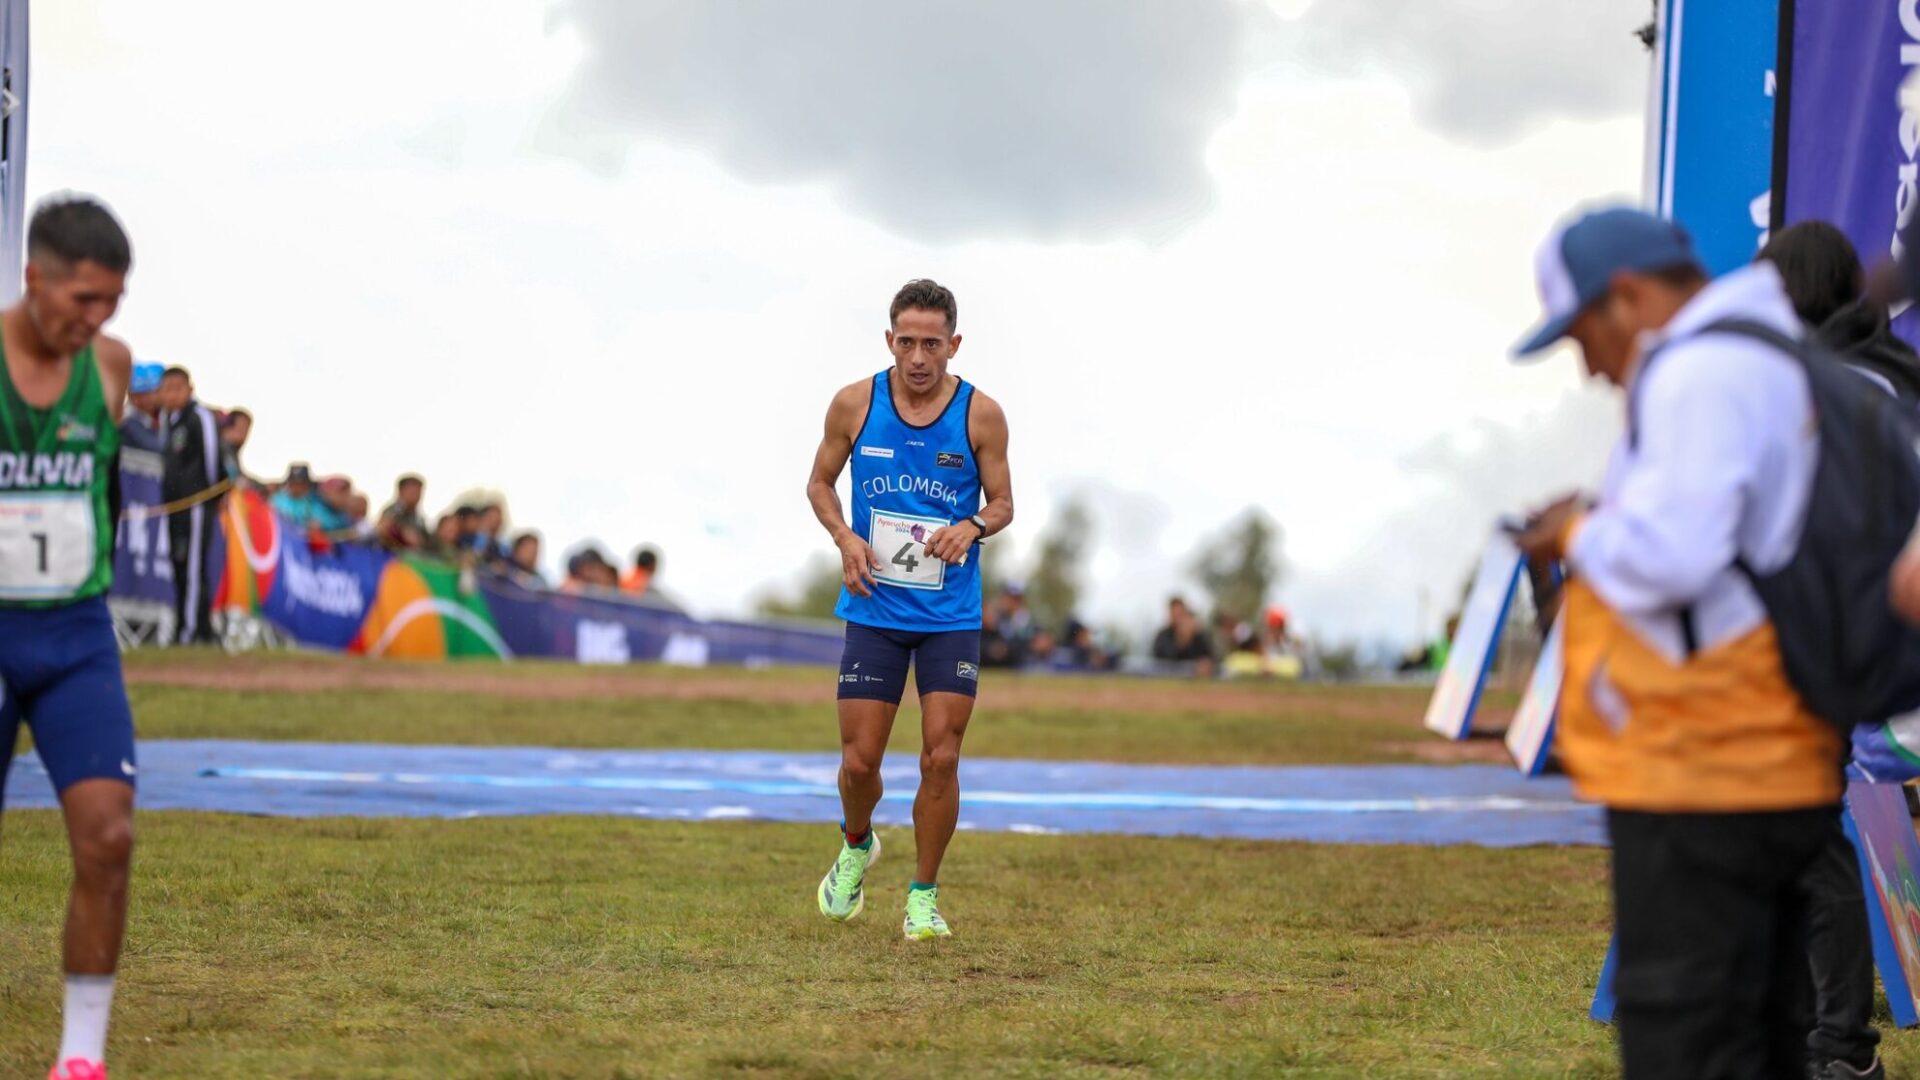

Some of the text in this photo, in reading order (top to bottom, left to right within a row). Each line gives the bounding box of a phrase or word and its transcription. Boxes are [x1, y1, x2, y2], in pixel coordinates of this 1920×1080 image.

[0, 452, 93, 487] OLIVIA
[863, 474, 957, 507] COLOMBIA
[31, 531, 48, 573] 1
[891, 542, 919, 573] 4
